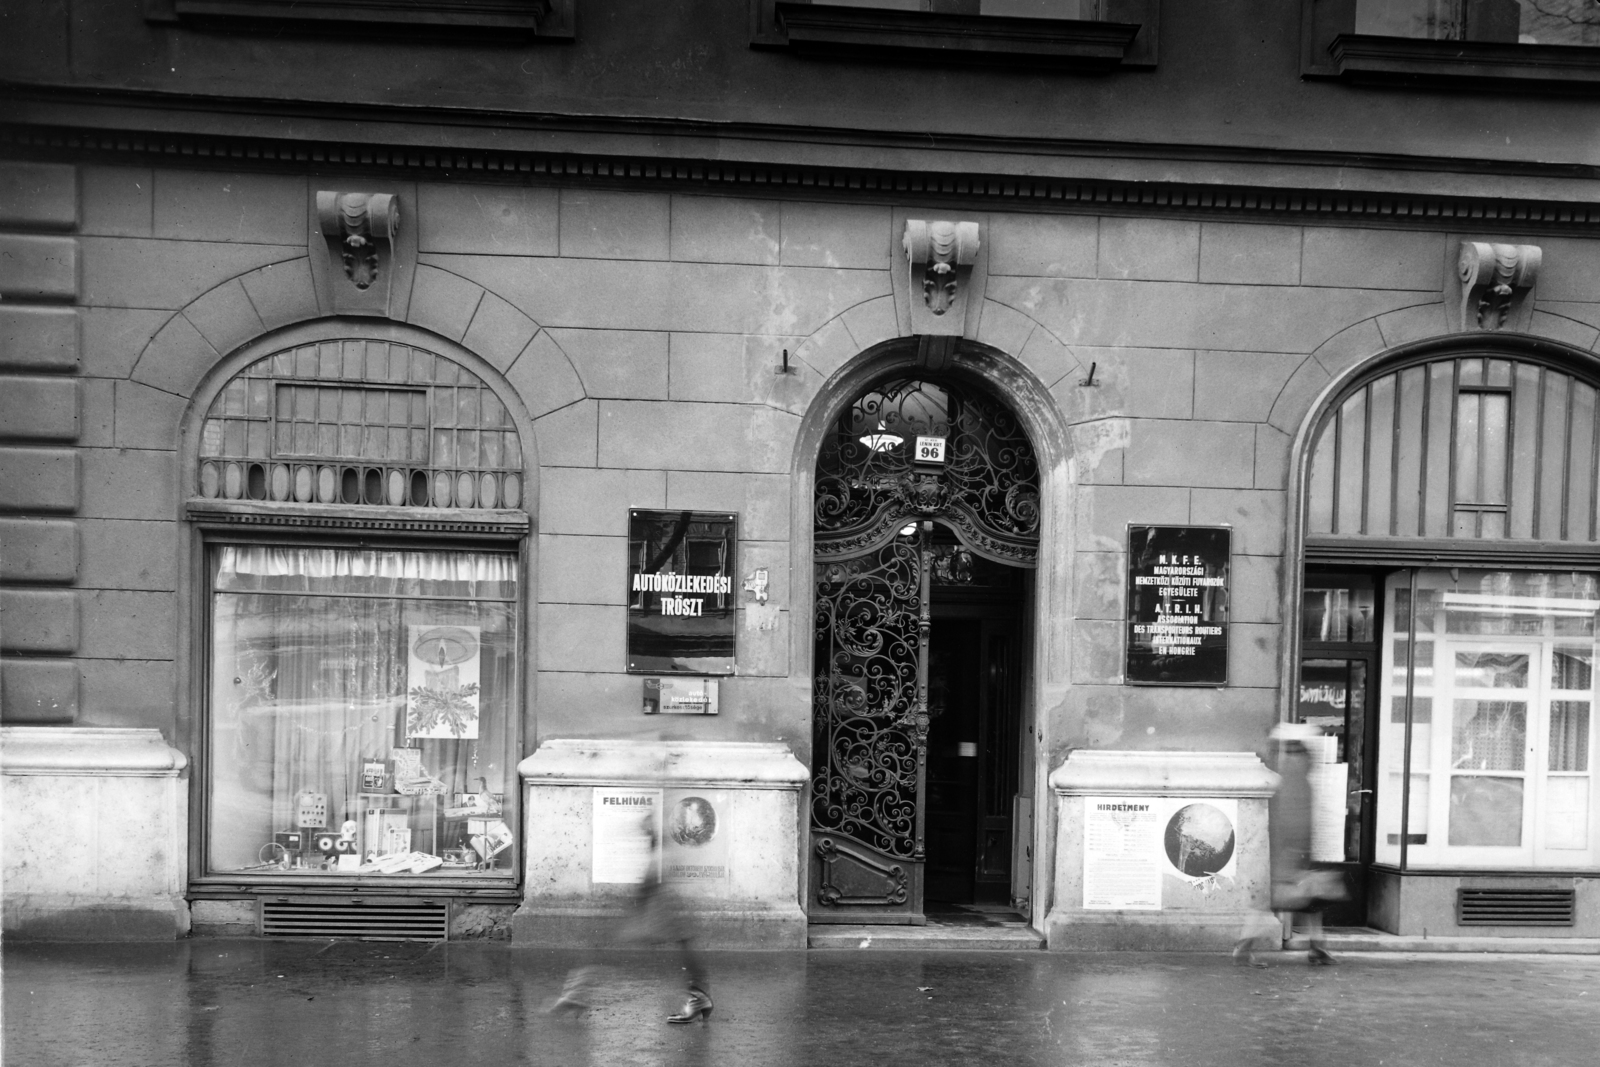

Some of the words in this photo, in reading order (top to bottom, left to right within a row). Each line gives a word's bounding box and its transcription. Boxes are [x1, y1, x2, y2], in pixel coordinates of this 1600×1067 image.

[921, 447, 939, 458] 96
[1154, 566, 1204, 575] MAGYARORSZÁGI
[632, 572, 731, 594] AUTÓKÖZLEKEDÉSI
[1135, 576, 1170, 585] NEMZETKÖZI
[1171, 576, 1191, 586] KÖZÚTI
[1192, 576, 1224, 586] FUVAROZÓK
[1159, 587, 1198, 597] EGYESÜLETE
[660, 595, 704, 617] TRÖSZT
[1157, 615, 1198, 624] ASSOCIATION
[1134, 625, 1145, 633] DES
[1146, 625, 1193, 634] TRANSPORTEURS
[1195, 626, 1222, 635] ROUTIERS
[1152, 636, 1202, 645] INTERNATIONAUX
[1159, 647, 1167, 655] EN
[1169, 647, 1195, 655] HONGRIE
[603, 796, 653, 806] FELHÍVÁS
